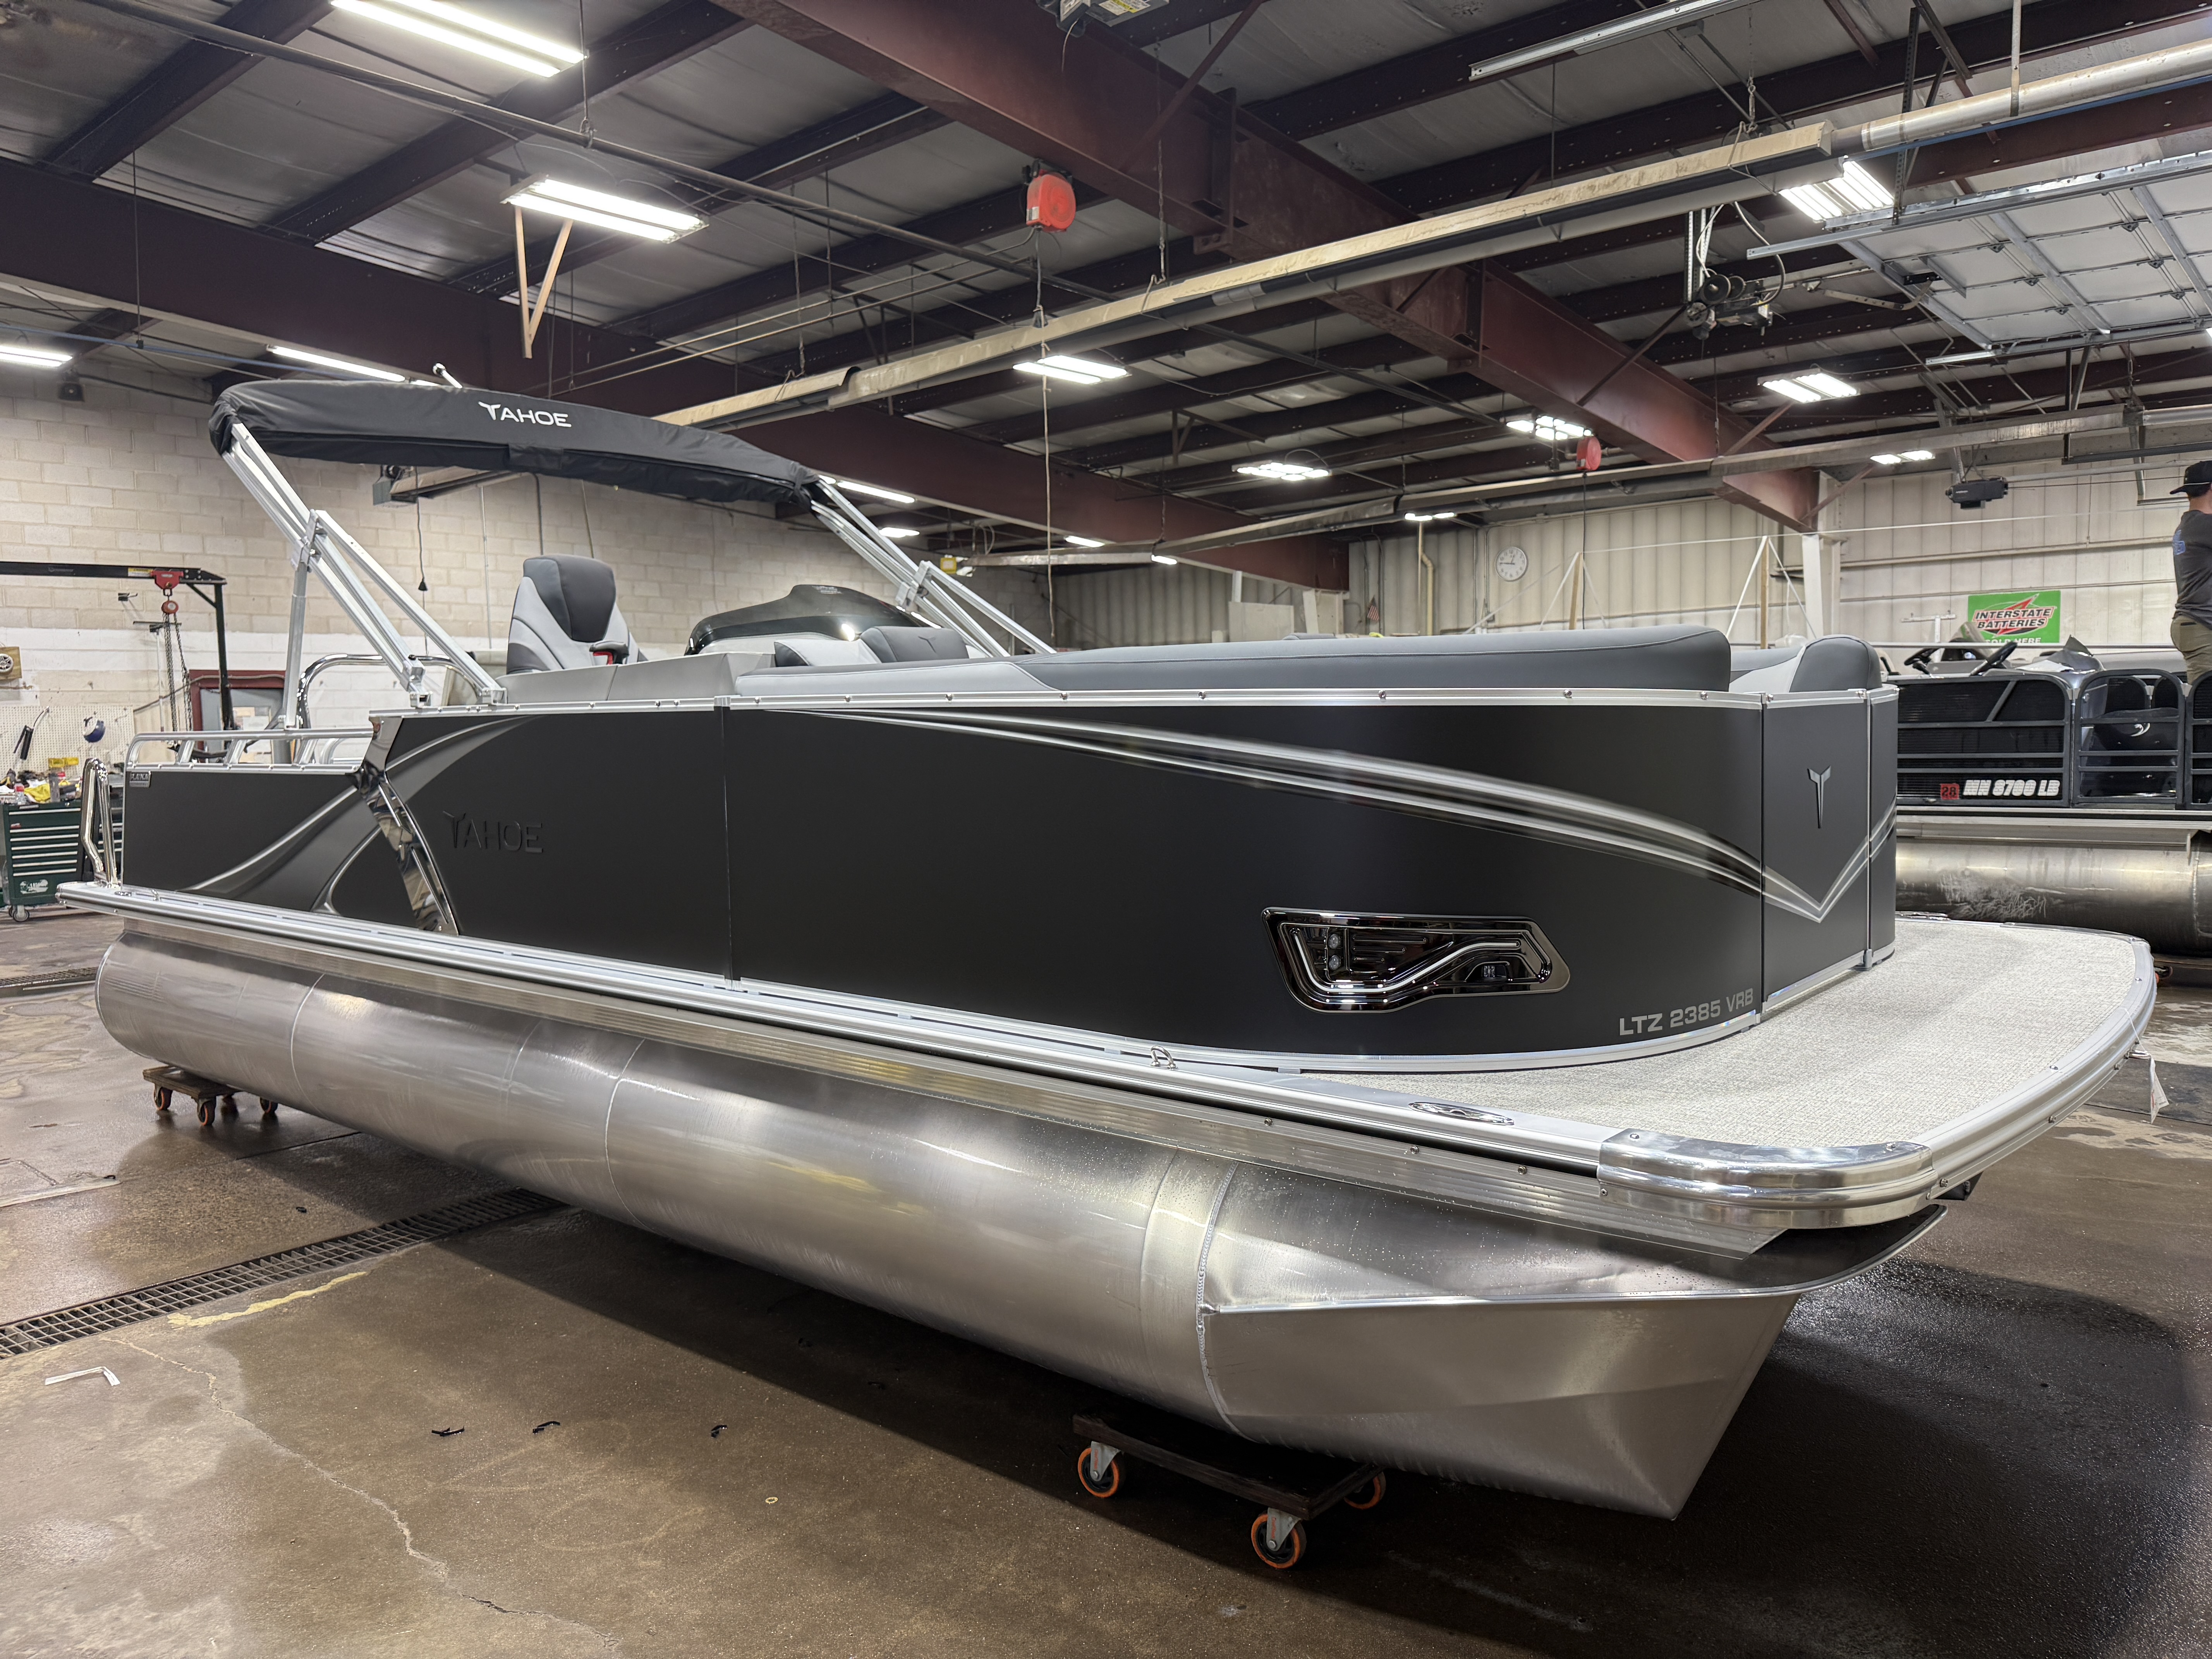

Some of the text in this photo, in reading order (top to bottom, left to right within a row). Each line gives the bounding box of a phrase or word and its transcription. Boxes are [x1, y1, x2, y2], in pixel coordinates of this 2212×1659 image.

[478, 401, 572, 428] TAHOE
[1975, 609, 2052, 619] INTERSTATE
[1977, 618, 2045, 629] BATTERIES
[1942, 787, 1957, 797] 28
[1963, 779, 2061, 796] MN 8700 LB
[443, 810, 544, 854] TAHOE
[1619, 988, 1753, 1036] LTZ 2385 VRB
